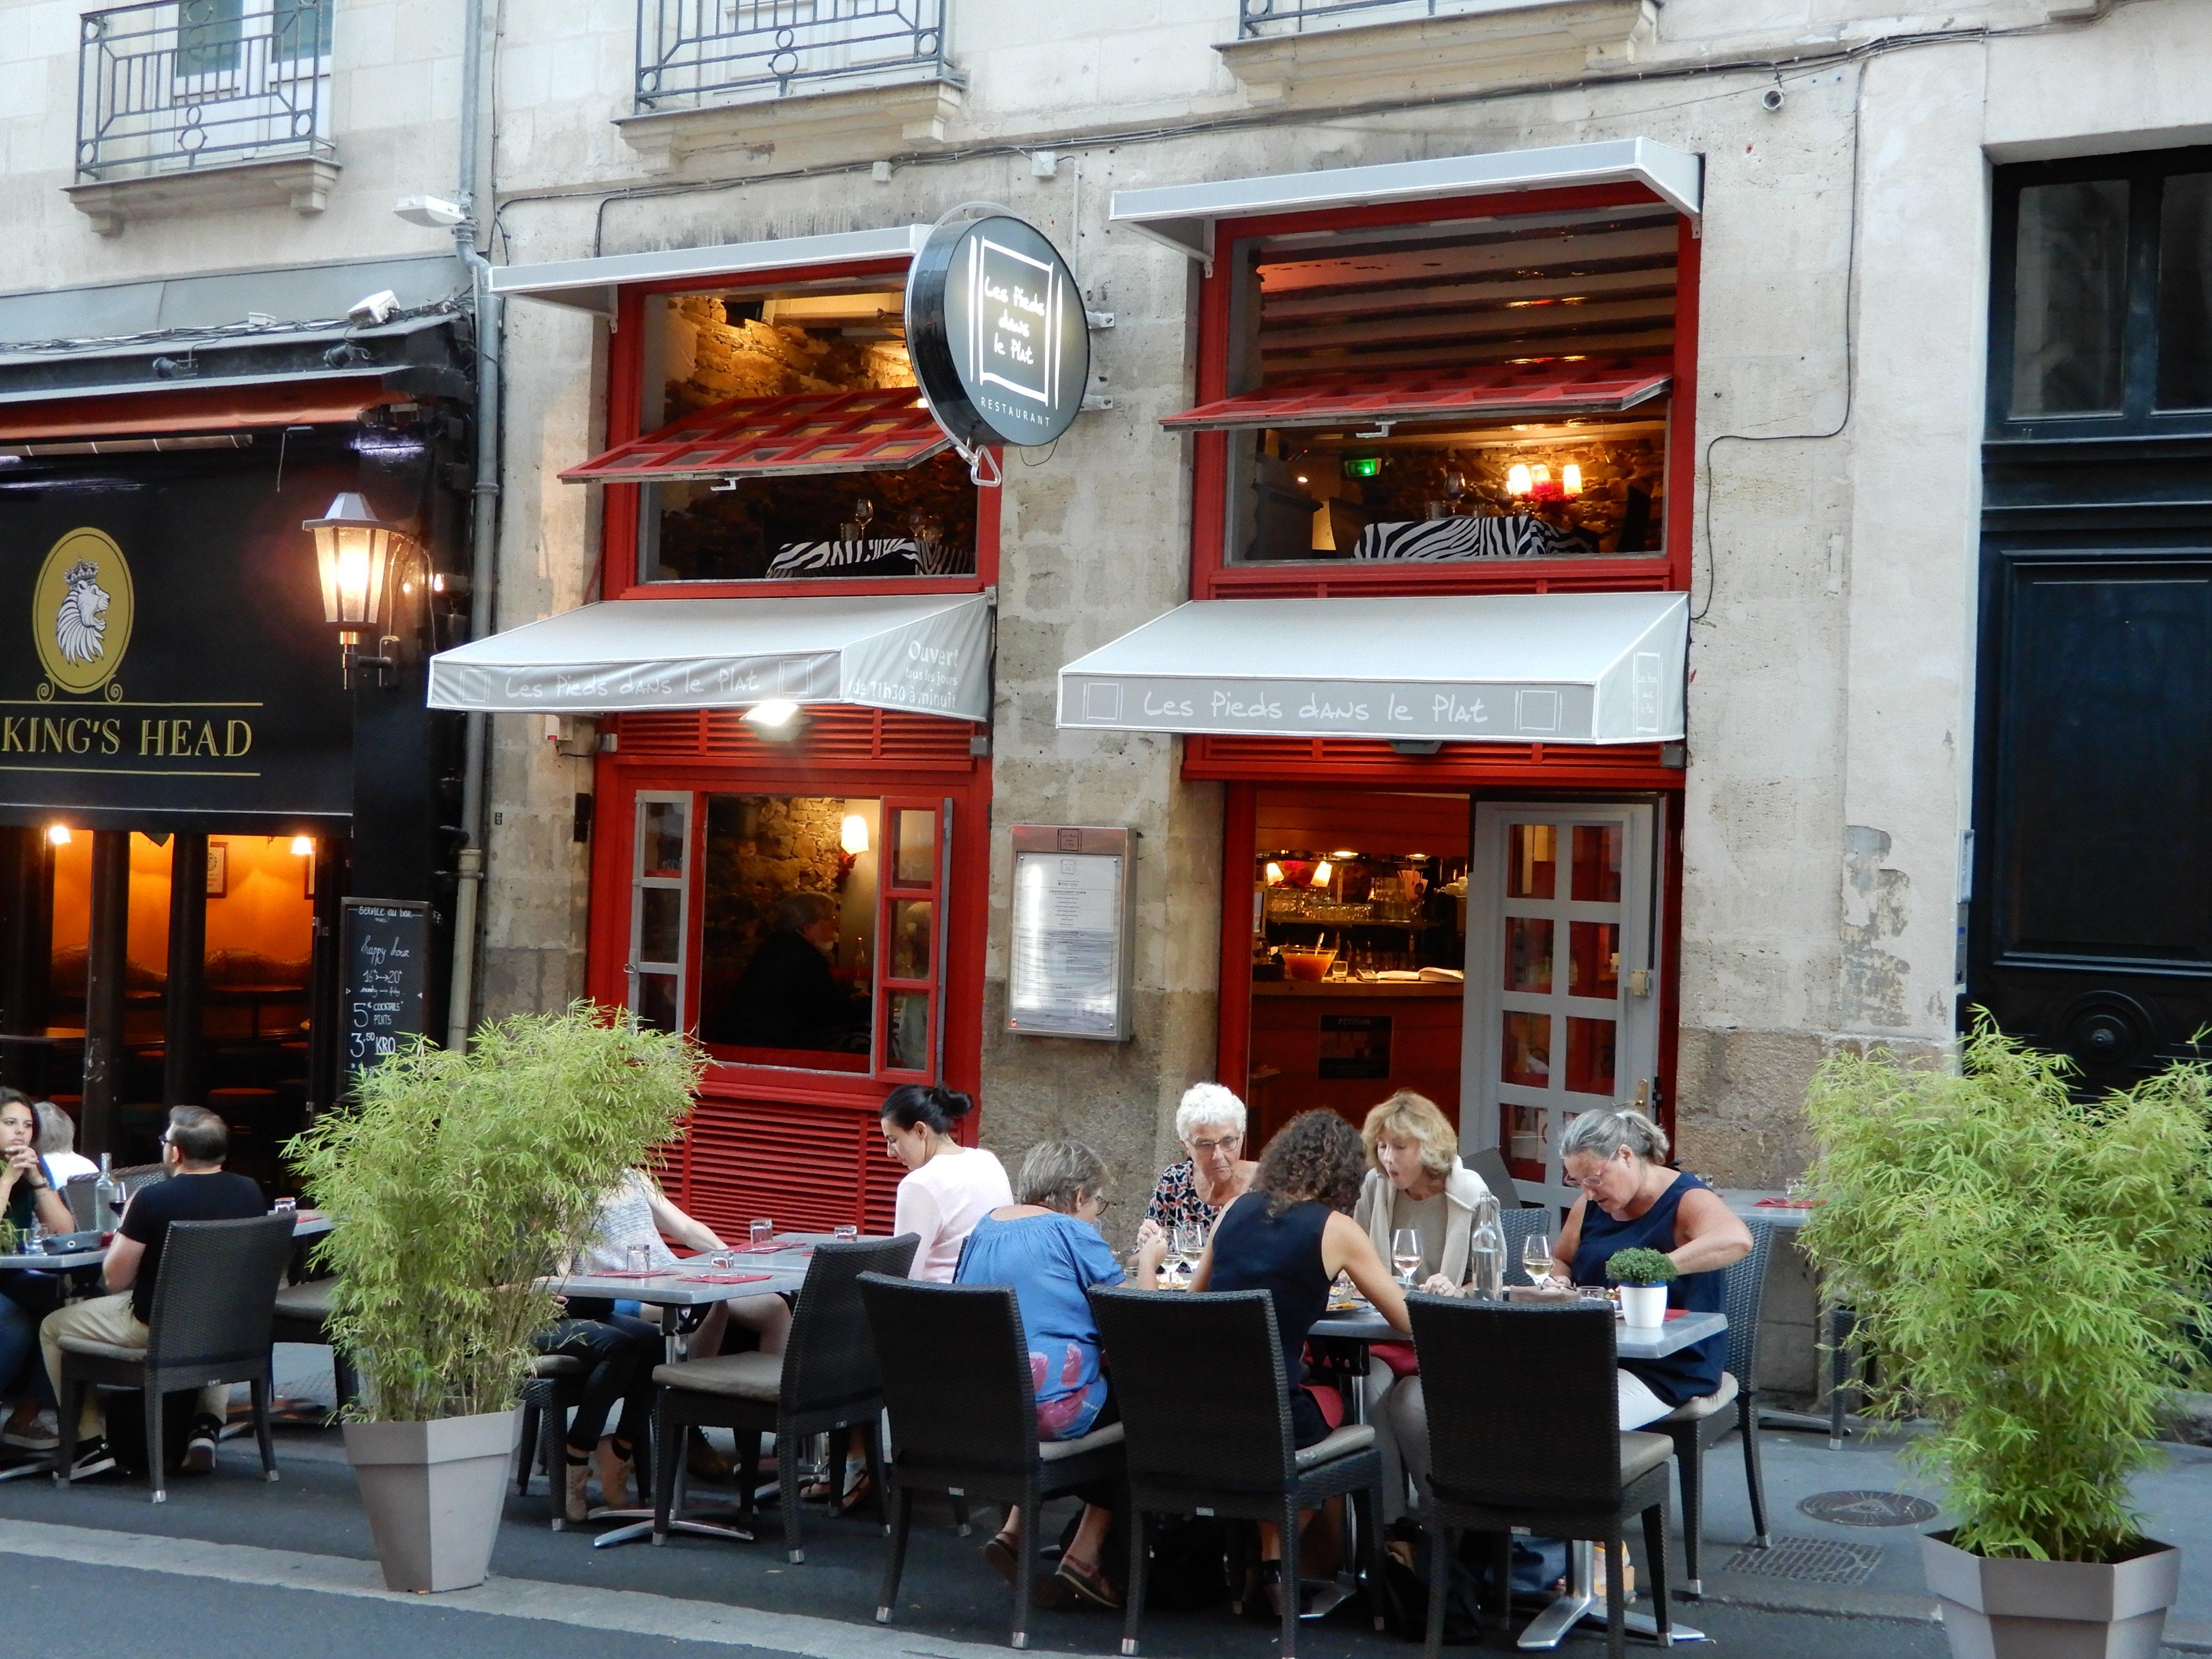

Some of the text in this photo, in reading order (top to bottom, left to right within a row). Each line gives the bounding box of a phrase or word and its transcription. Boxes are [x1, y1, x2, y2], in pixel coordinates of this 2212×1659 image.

[984, 276, 1045, 316] Les Pieds
[993, 332, 1006, 355] le
[981, 396, 1050, 427] RESTAURANT
[908, 640, 959, 668] Ouvert
[506, 676, 543, 699] Les
[556, 674, 608, 698] Pieds
[685, 669, 704, 694] le
[905, 667, 957, 686] tous les jours
[909, 685, 915, 703] à
[918, 689, 956, 709] minuit
[1144, 690, 1194, 716] Les
[1211, 691, 1282, 719] Pieds
[1388, 693, 1413, 721] le
[1, 716, 252, 757] KING'S HEAD
[361, 935, 410, 966] happy hour
[375, 1036, 396, 1054] KRO
